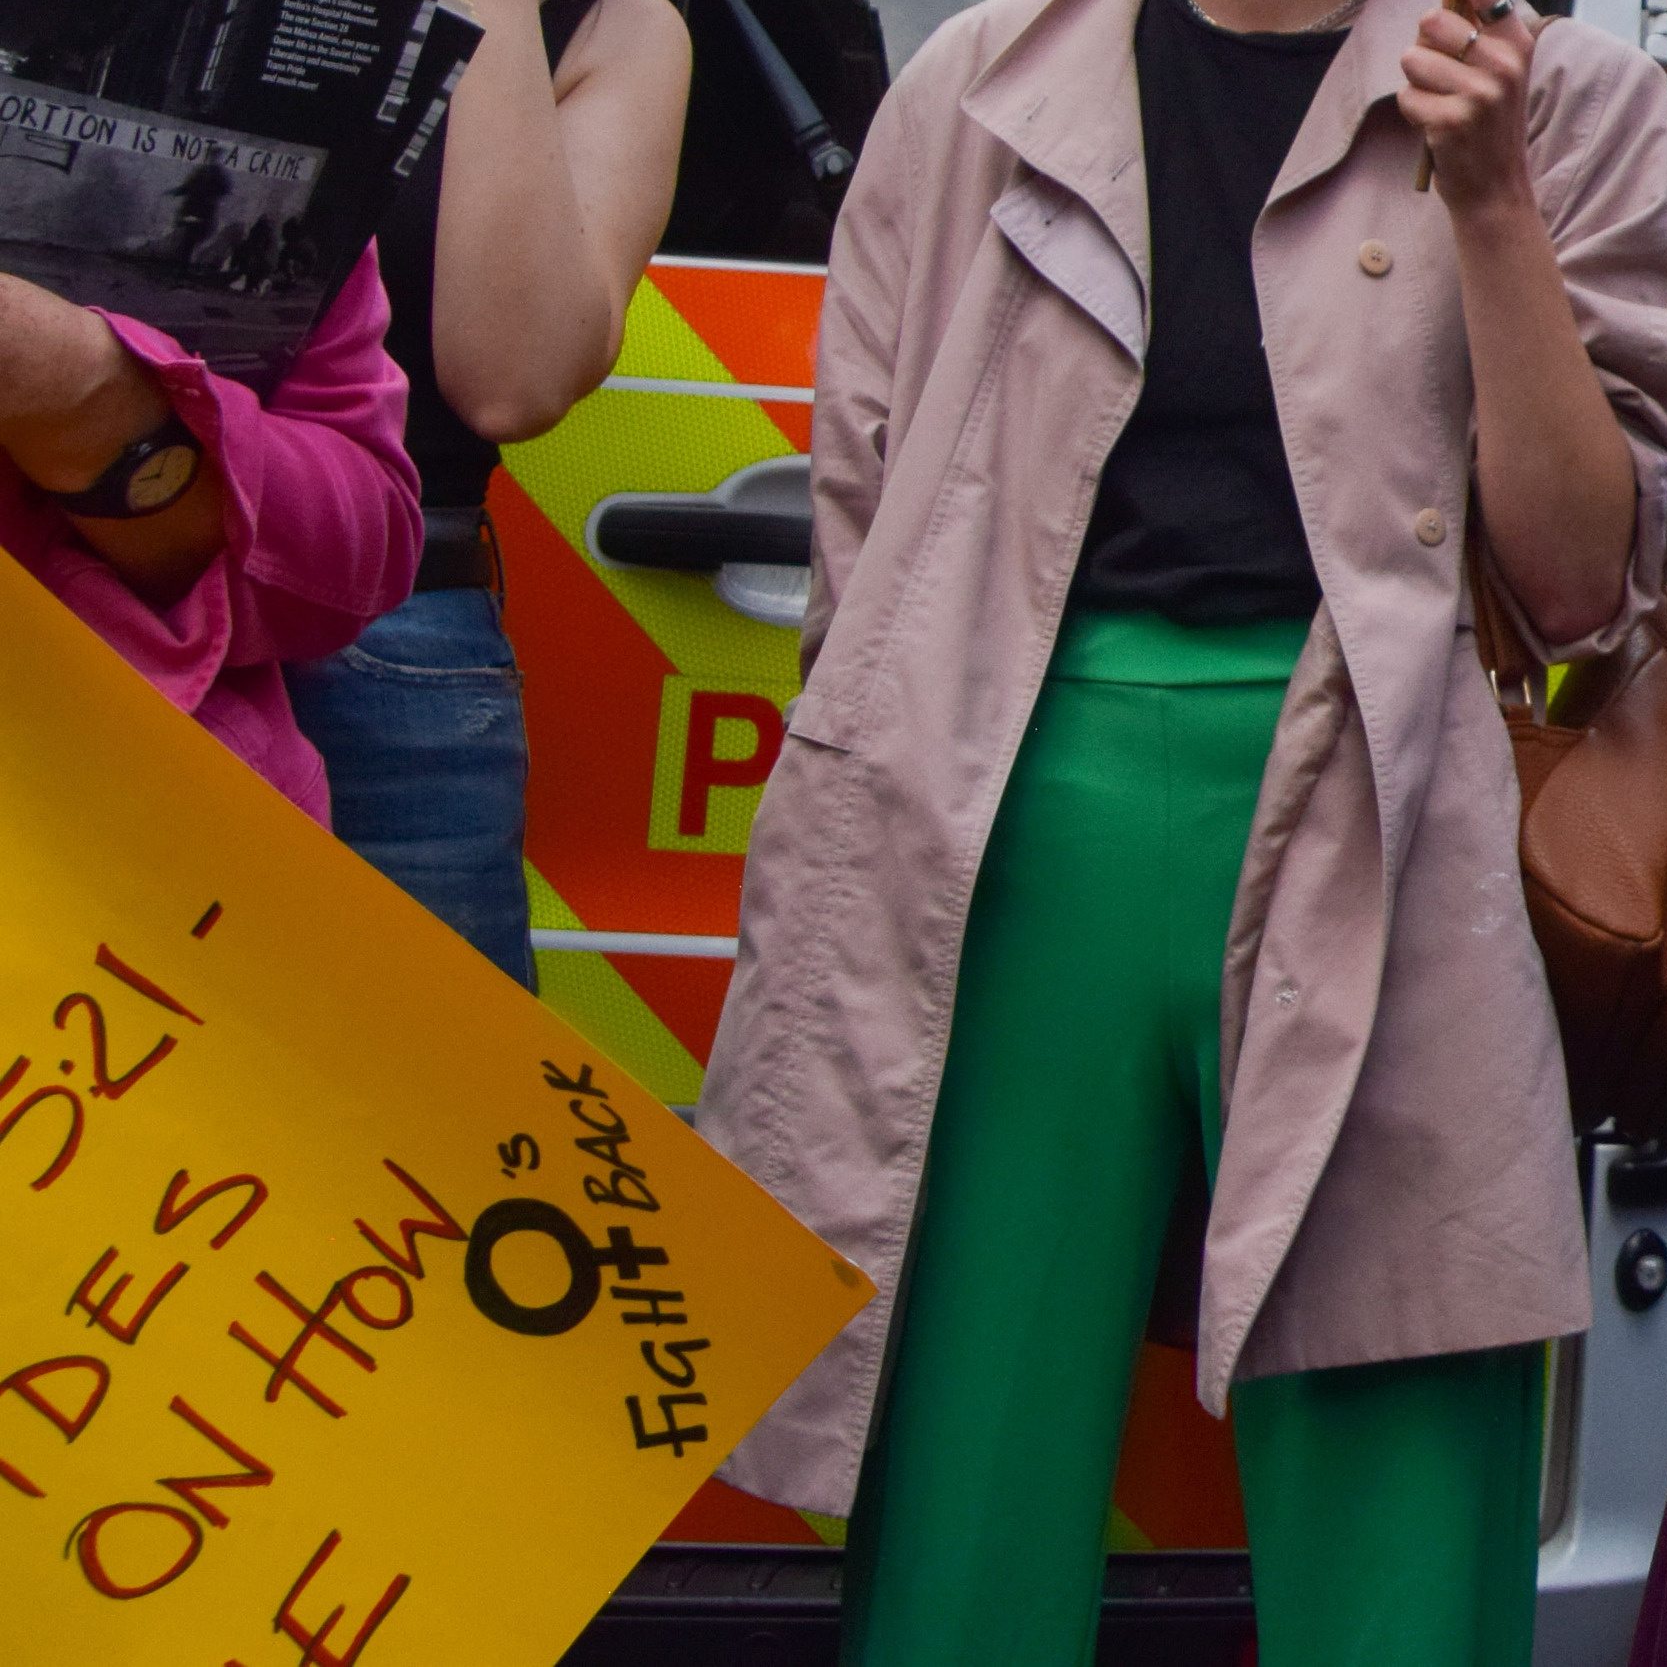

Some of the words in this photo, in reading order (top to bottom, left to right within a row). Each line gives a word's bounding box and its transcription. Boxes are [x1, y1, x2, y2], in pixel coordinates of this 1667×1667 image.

[132, 126, 157, 153] IS
[173, 133, 216, 161] NOT
[249, 149, 306, 179] CRIME
[540, 1059, 661, 1213] BACK
[63, 1394, 275, 1600] ON
[228, 1158, 470, 1419] HOW
